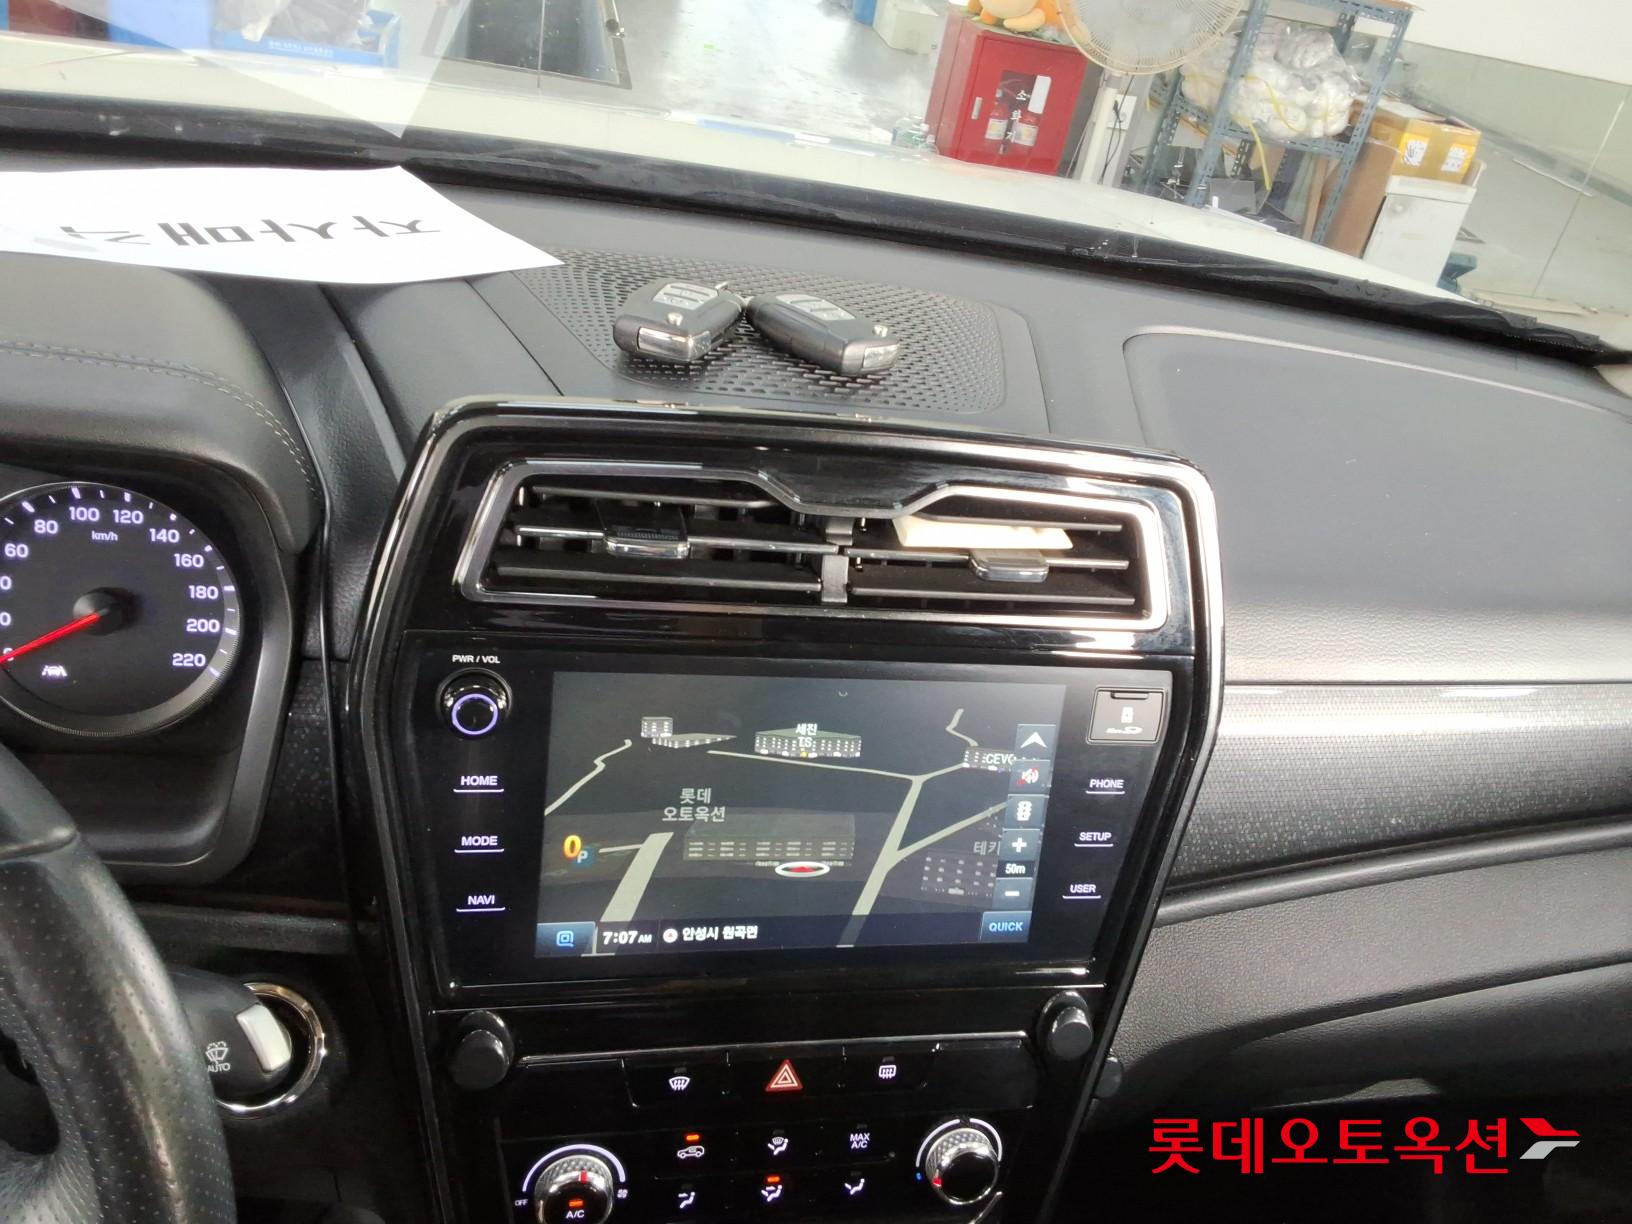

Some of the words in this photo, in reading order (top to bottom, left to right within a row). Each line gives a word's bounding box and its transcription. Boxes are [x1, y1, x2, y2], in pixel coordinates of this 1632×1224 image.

[69, 506, 100, 522] 100
[113, 509, 144, 524] 120
[34, 519, 59, 535] 80
[91, 530, 118, 542] km/h
[149, 528, 180, 544] 140
[4, 543, 29, 558] 60
[174, 553, 204, 568] 160
[188, 585, 219, 600] 180
[186, 618, 220, 634] 200
[172, 652, 206, 668] 220
[452, 654, 474, 663] PWR
[481, 655, 501, 664] VOL
[460, 775, 498, 786] HOME
[1089, 778, 1125, 790] PHONE
[680, 787, 712, 804] 롯데
[661, 806, 726, 823] 오토옥션
[461, 835, 498, 847] MODE
[1078, 831, 1112, 843] SETUP
[1005, 863, 1027, 875] 50m
[1069, 883, 1097, 894] USER
[467, 895, 495, 906] NAVI
[682, 926, 718, 941] 안성시
[722, 925, 758, 940] 원곡면
[988, 921, 1024, 933] QUICK
[603, 931, 638, 945] 7:07
[206, 1062, 231, 1073] AUTO
[850, 1132, 870, 1142] MAX
[851, 1140, 868, 1149] A/C
[566, 1209, 585, 1220] A/C
